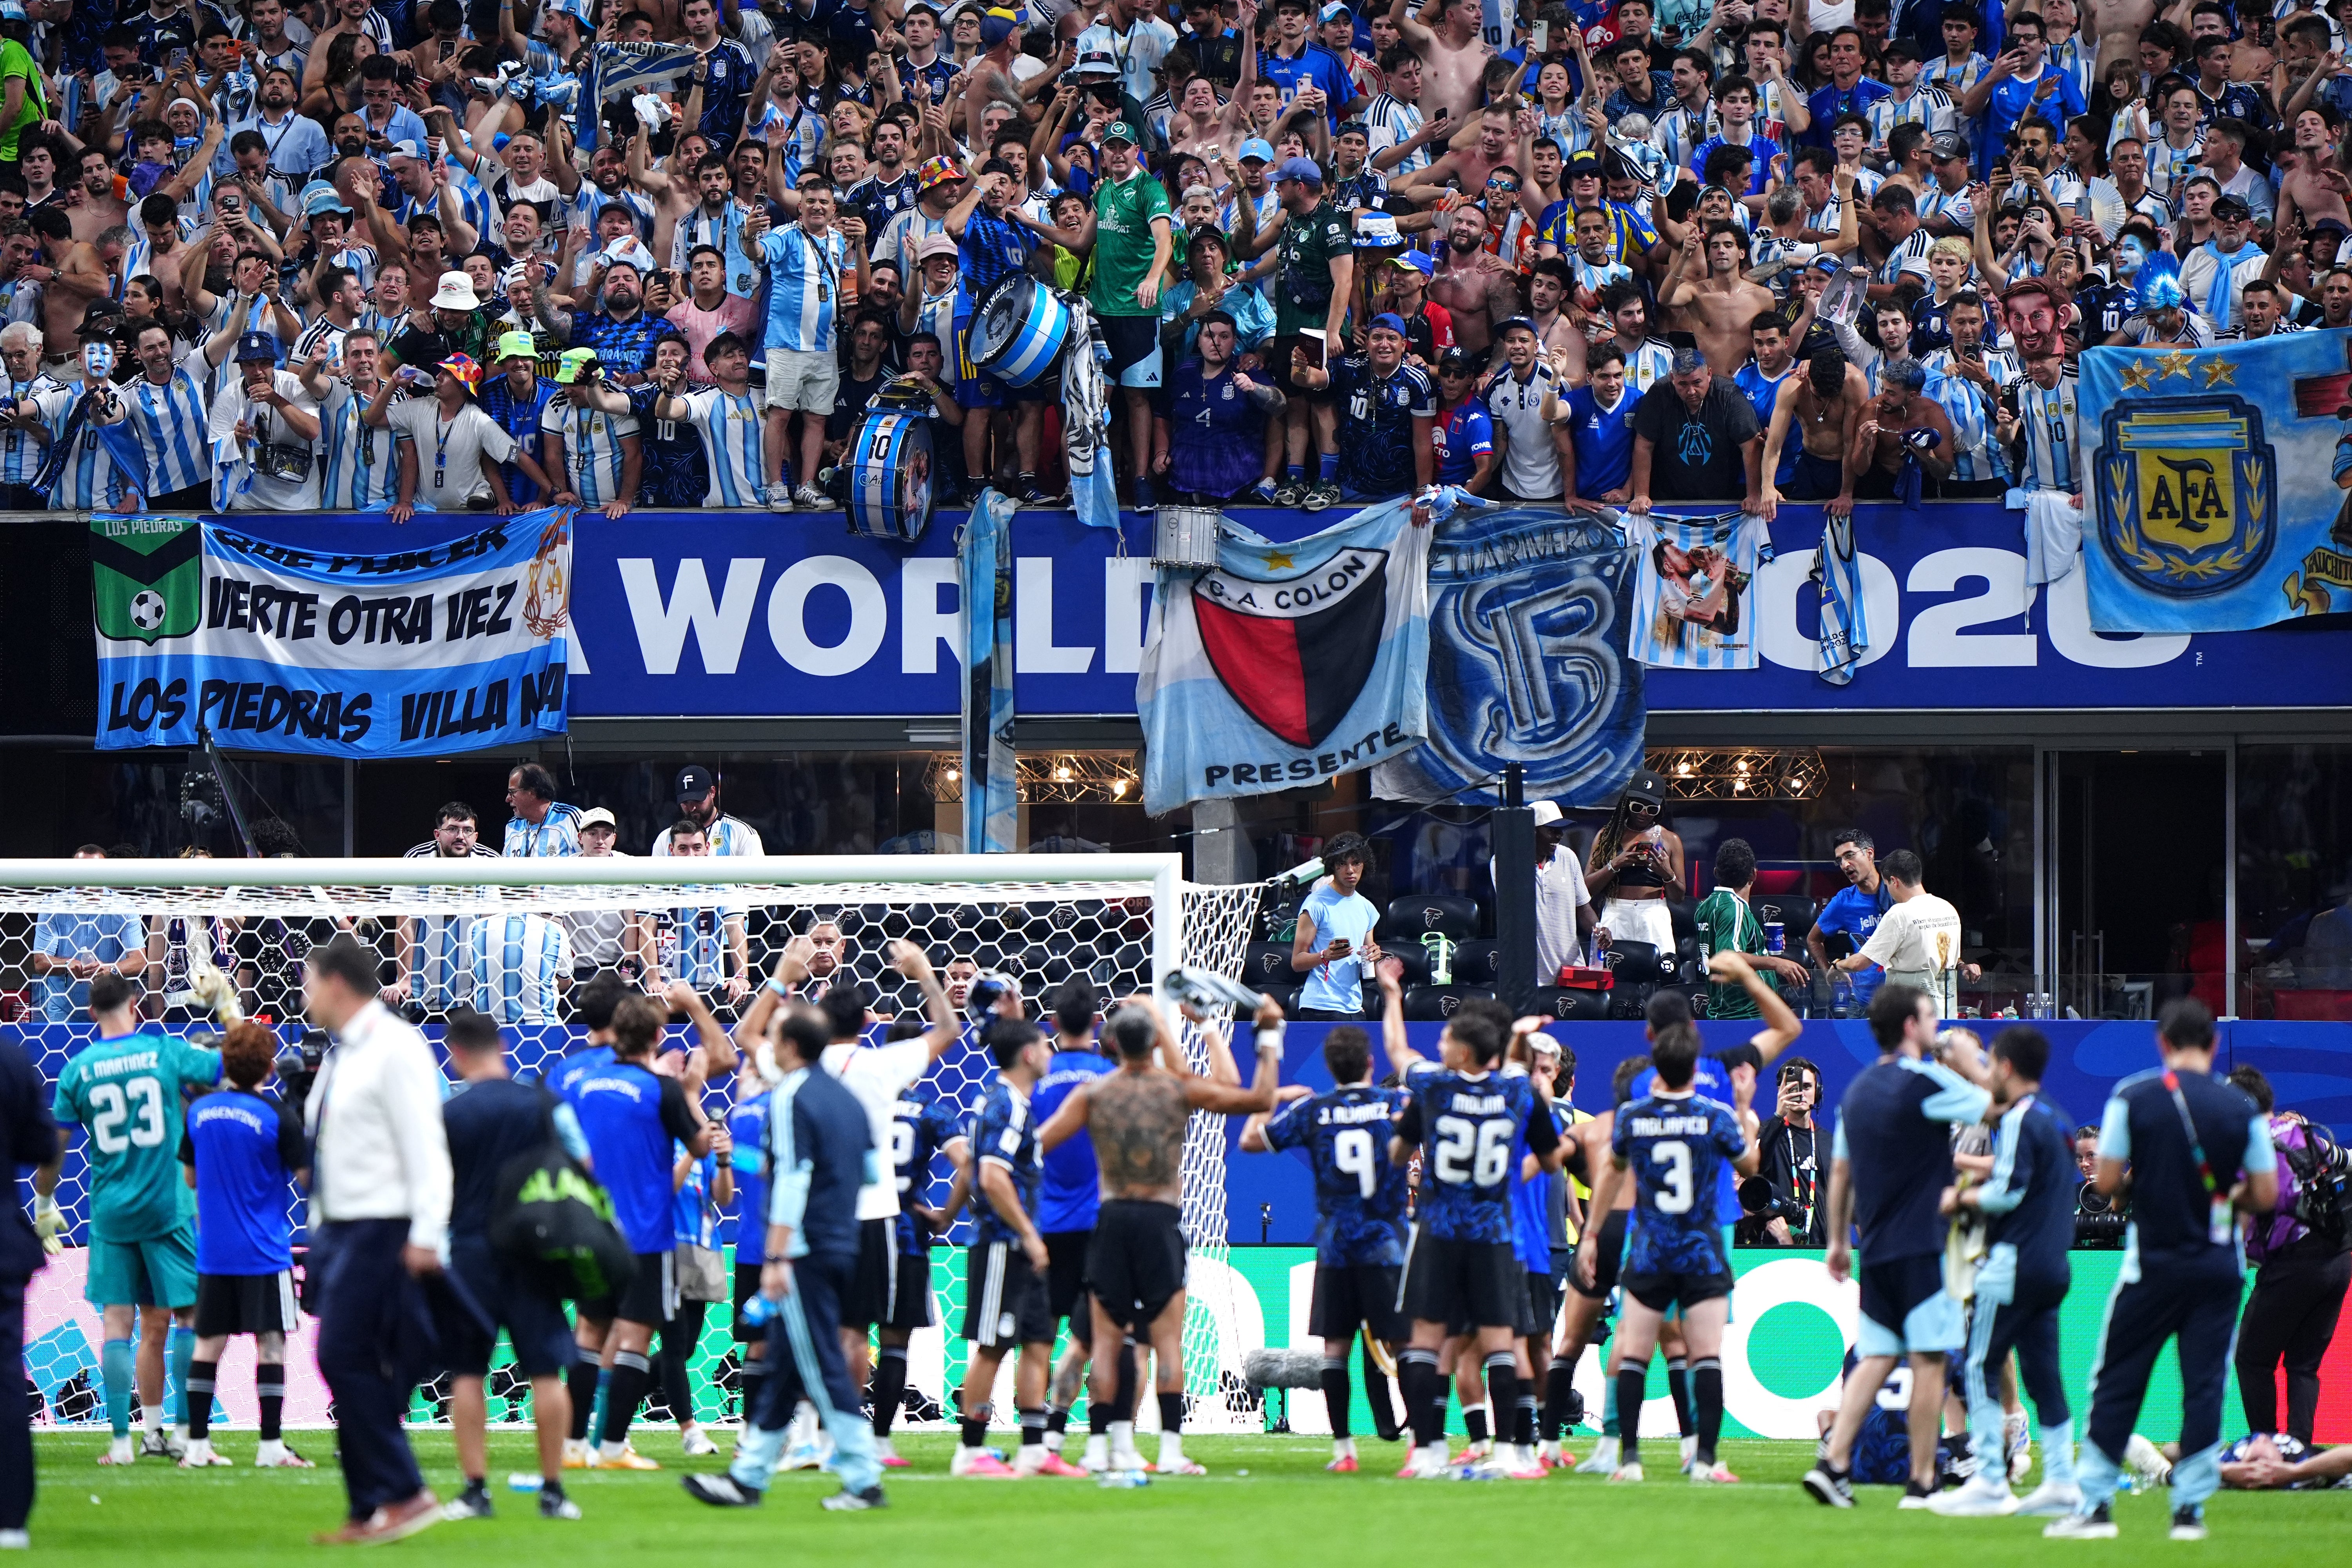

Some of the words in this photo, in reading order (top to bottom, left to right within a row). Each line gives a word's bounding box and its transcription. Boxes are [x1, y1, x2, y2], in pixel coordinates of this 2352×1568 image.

[1675, 10, 1710, 24] Coca-Cola
[307, 189, 330, 200] ARGENTINA
[1326, 234, 1345, 243] SIGMA
[1328, 240, 1347, 248] AGRO
[981, 278, 1016, 316] HINCHAS
[2103, 310, 2119, 332] 10
[595, 348, 644, 369] THRASHER
[1450, 347, 1461, 356] NY
[1195, 408, 1210, 427] 4
[1350, 395, 1367, 420] 10
[656, 419, 676, 441] 10
[2046, 420, 2067, 444] 10
[867, 434, 891, 460] 10
[2147, 455, 2228, 533] AFA
[105, 521, 128, 536] LOS
[131, 521, 183, 534] PIEDRAS
[1209, 579, 1230, 601] C.
[1240, 592, 1264, 610] A.
[1274, 555, 1366, 611] COLON
[206, 576, 319, 641] VERTE
[328, 593, 434, 646] OTRA
[445, 580, 518, 642] VEZ
[107, 677, 187, 733] LOS
[197, 679, 372, 744] PIEDRAS
[400, 675, 510, 742] VILLA
[1205, 720, 1405, 787] PRESENTE
[512, 849, 521, 857] 10
[94, 1052, 157, 1078] MARTINEZ
[89, 1077, 164, 1154] 23
[196, 1106, 261, 1134] ARGENTINA
[1435, 1116, 1515, 1187] 26
[1334, 1129, 1376, 1200] 9
[1651, 1141, 1694, 1214] 3
